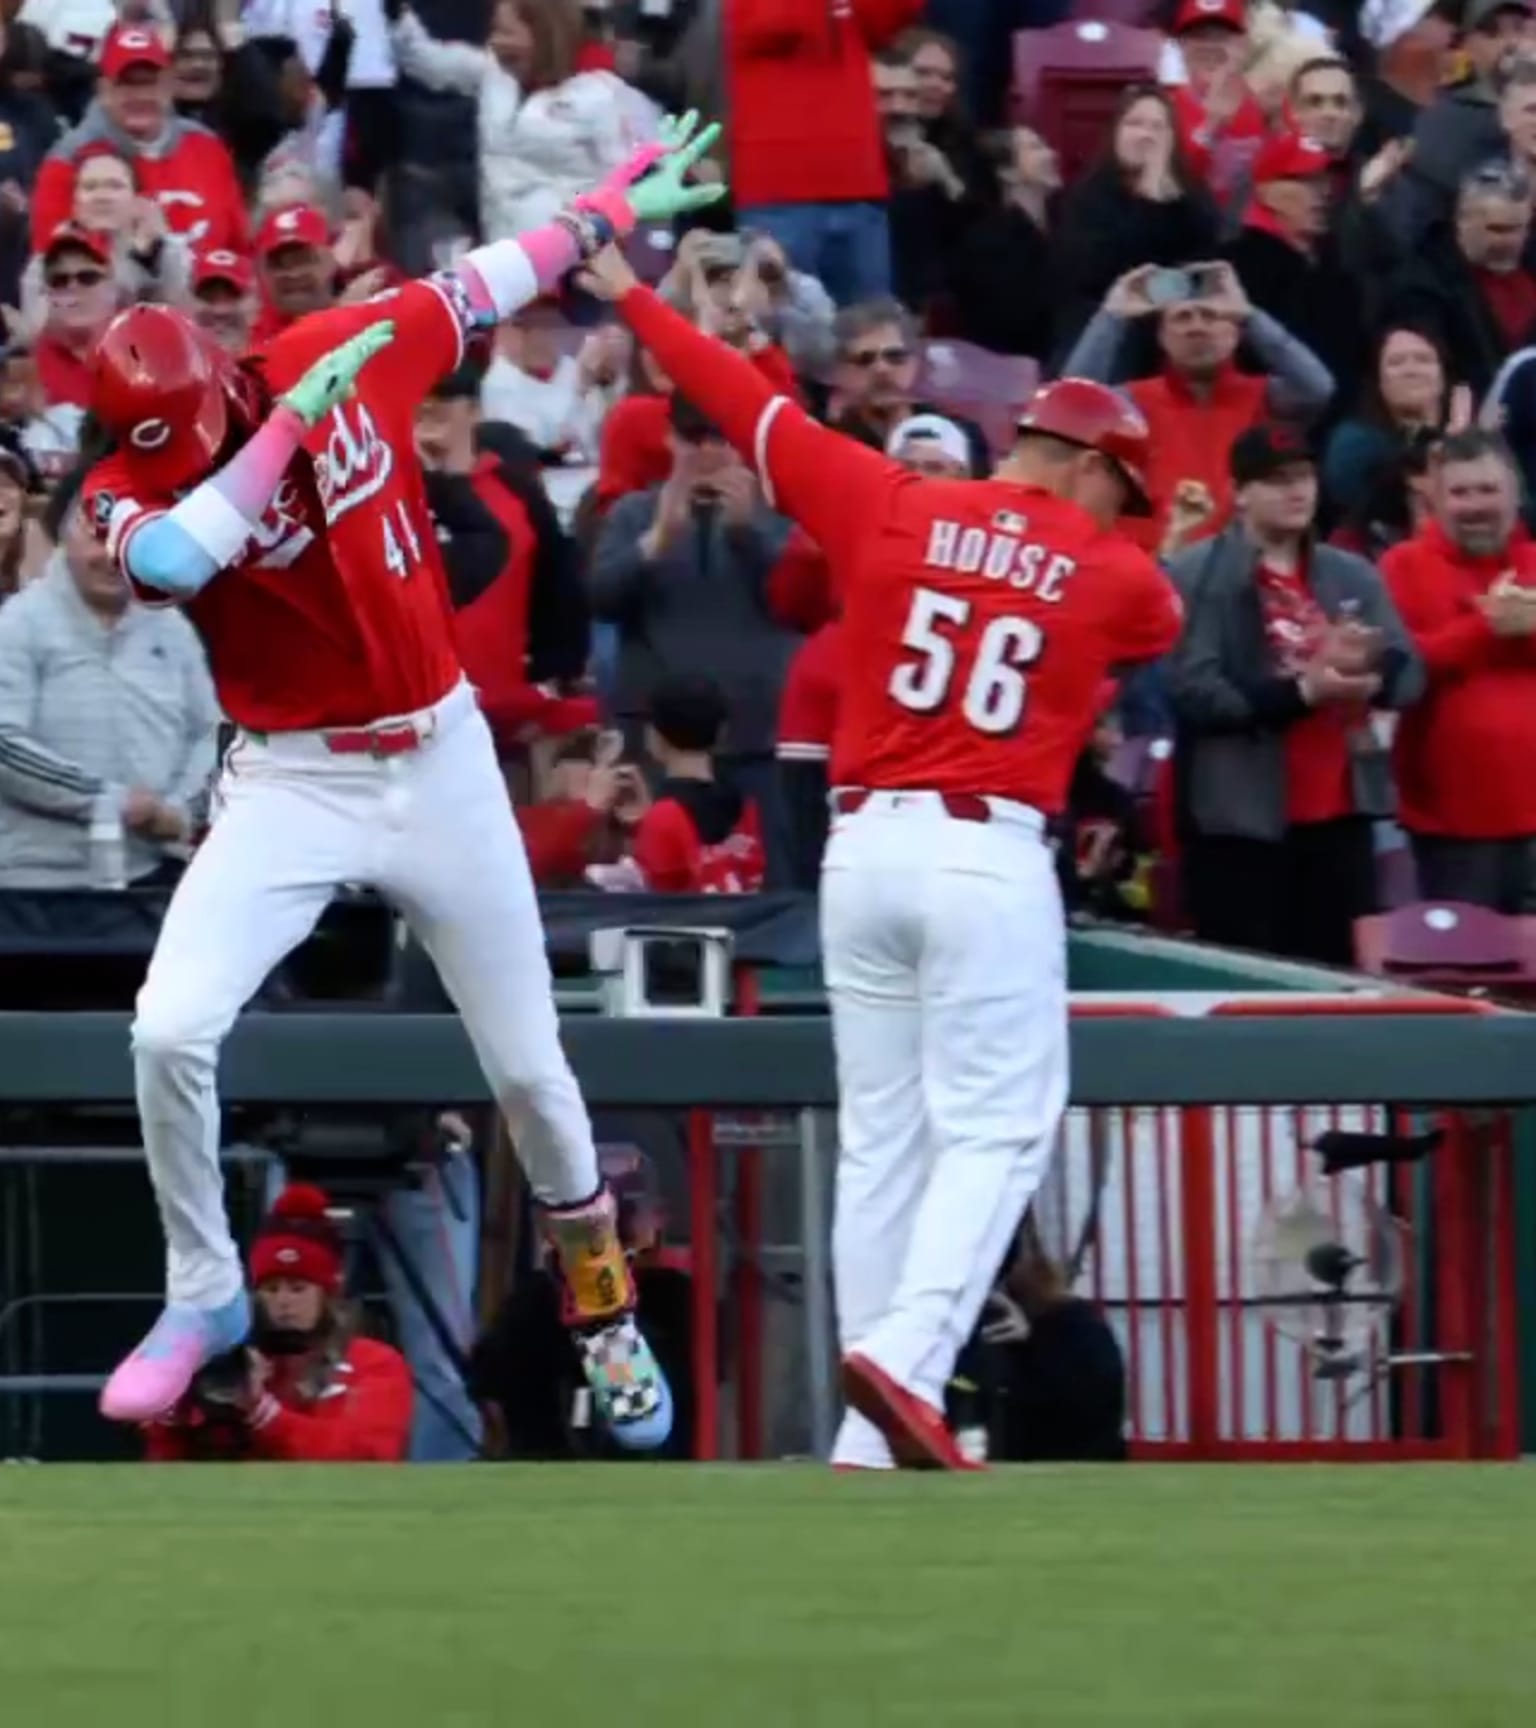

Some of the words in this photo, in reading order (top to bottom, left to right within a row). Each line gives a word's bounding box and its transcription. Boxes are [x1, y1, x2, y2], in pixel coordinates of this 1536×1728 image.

[130, 417, 172, 449] C
[925, 519, 1076, 602] HOUSE
[887, 586, 1044, 734] 56
